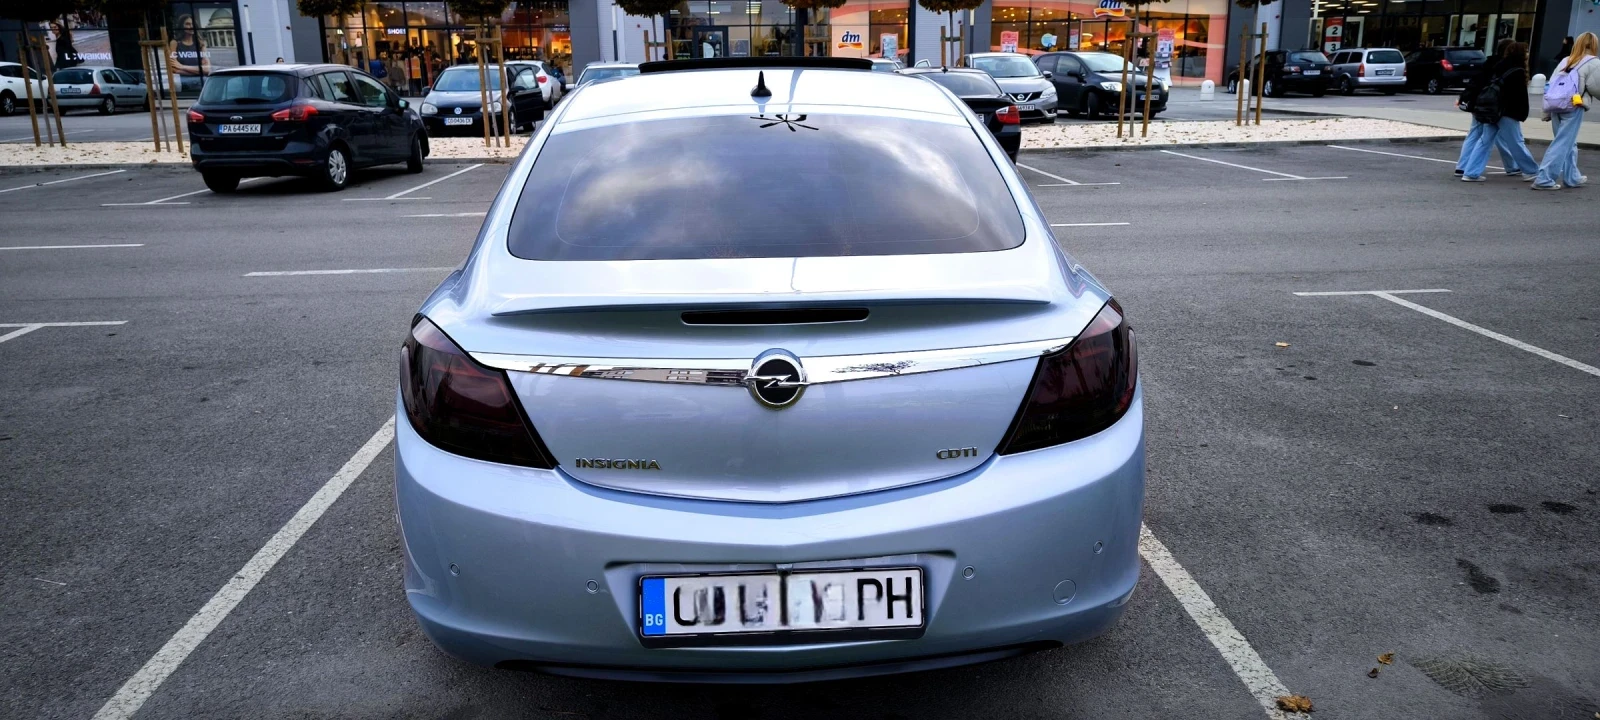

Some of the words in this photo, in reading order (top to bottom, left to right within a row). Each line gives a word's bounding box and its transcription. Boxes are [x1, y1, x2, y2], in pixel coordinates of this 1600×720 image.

[842, 31, 860, 42] dm
[1332, 26, 1338, 35] 2
[1330, 43, 1336, 51] 3
[936, 446, 977, 460] CDTI
[575, 457, 662, 470] INSIGNIA
[857, 577, 913, 621] PH
[645, 613, 663, 626] BG
